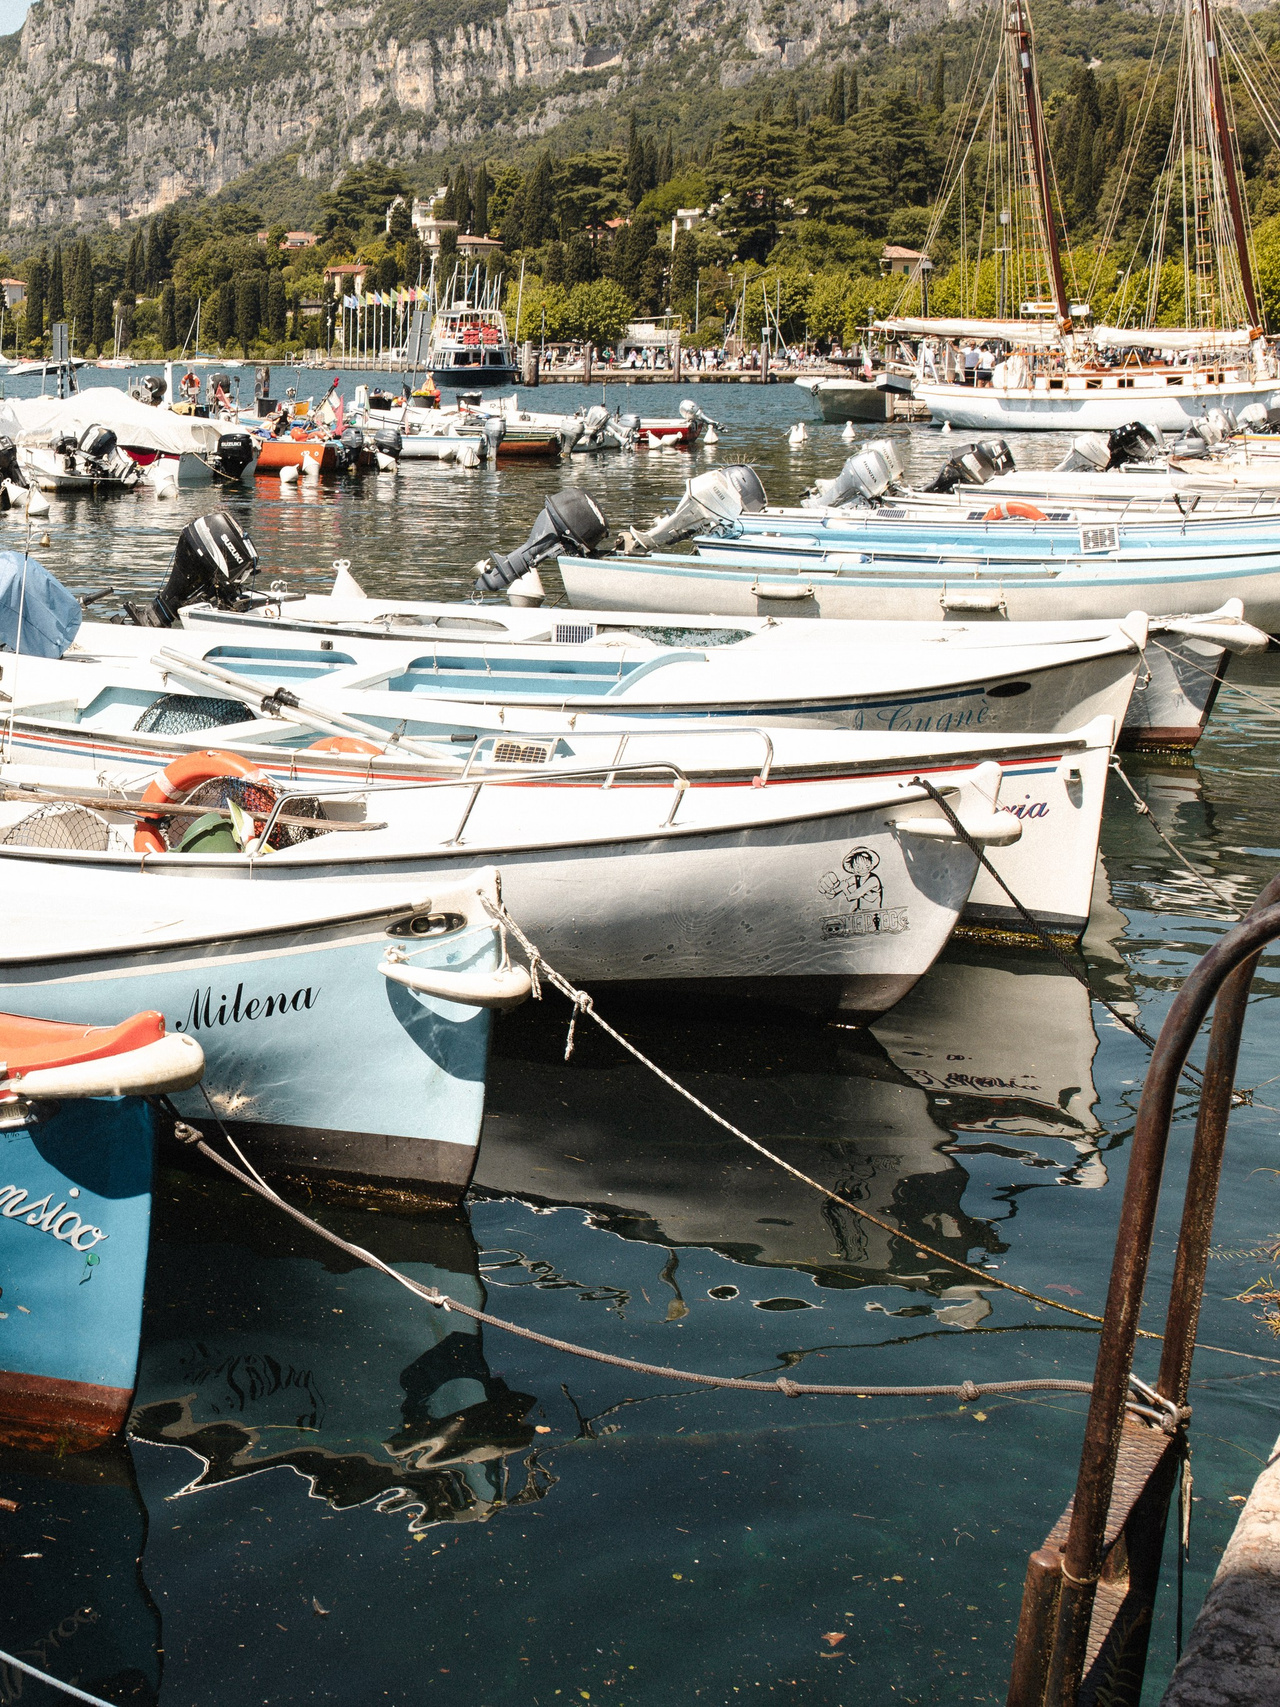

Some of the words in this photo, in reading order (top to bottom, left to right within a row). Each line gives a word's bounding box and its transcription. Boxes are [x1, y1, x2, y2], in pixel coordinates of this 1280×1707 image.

[863, 460, 877, 483] HONDA
[221, 533, 244, 565] SUZUKI
[175, 983, 322, 1033] Milena
